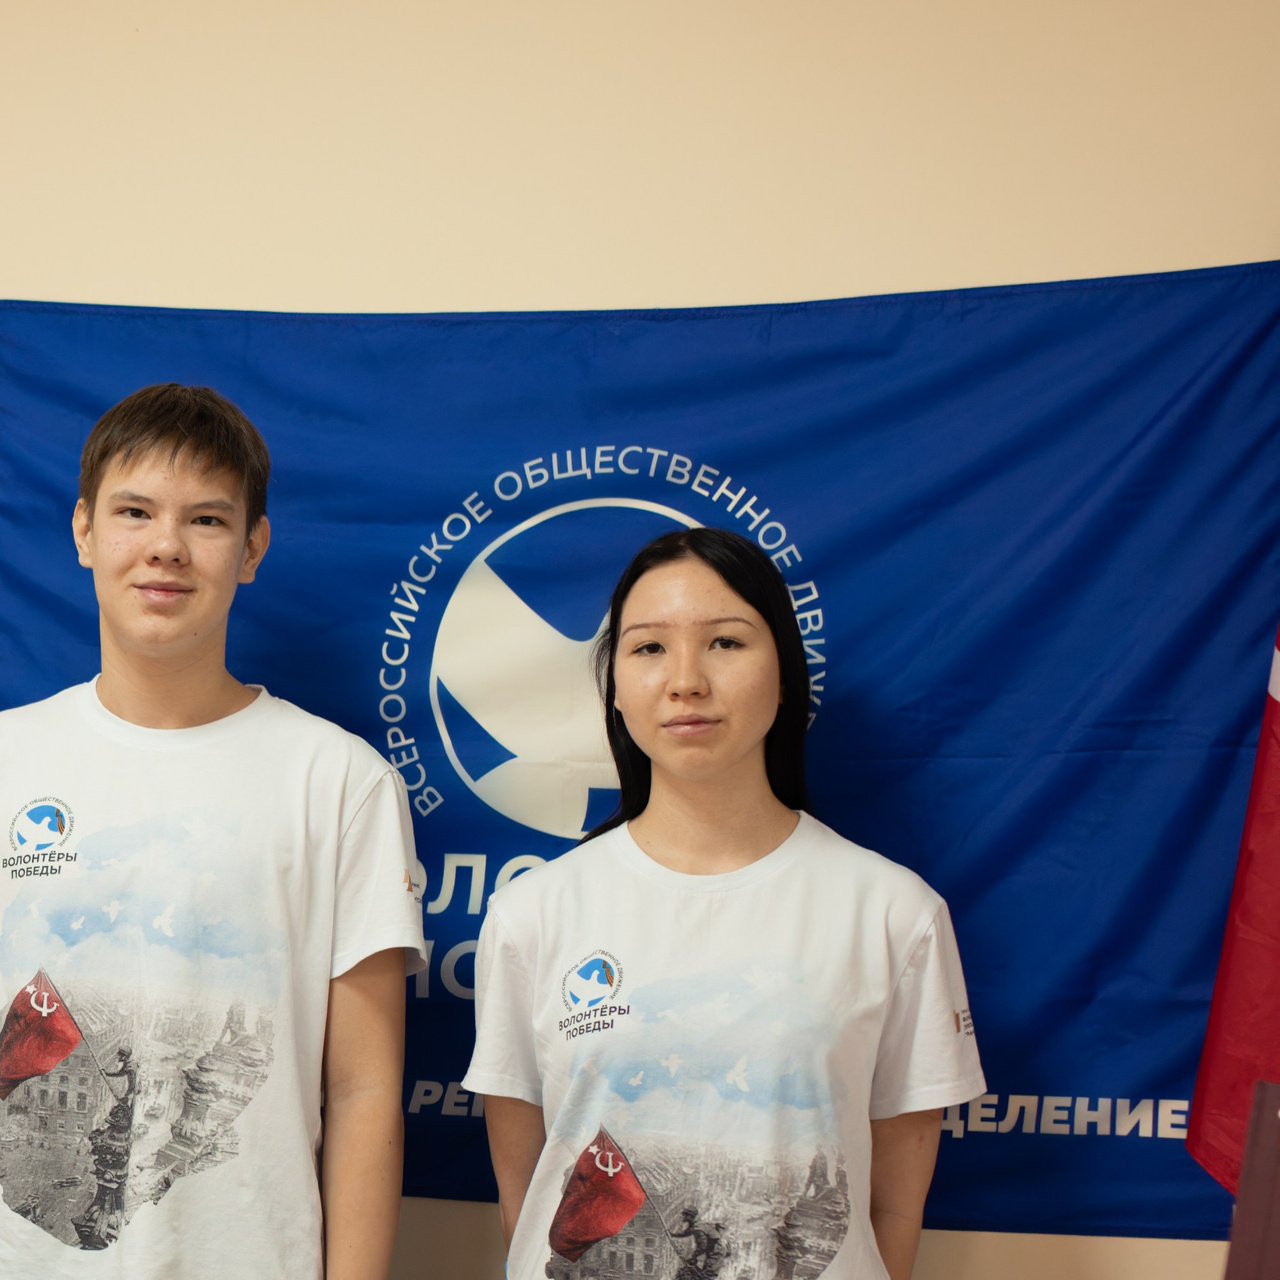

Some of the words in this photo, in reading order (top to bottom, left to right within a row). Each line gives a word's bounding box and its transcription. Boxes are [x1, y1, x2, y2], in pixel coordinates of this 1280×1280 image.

[379, 490, 494, 818] ВСЕРОССИЙСКОЕ
[494, 445, 803, 572] ОБЩЕСТВЕННОЕ
[2, 851, 77, 868] ВОЛОНТЁРЫ
[11, 865, 61, 879] ПОБЕДЫ
[559, 1004, 630, 1031] ВОЛОНТЁРЫ
[566, 1019, 614, 1041] ПОБЕДЫ
